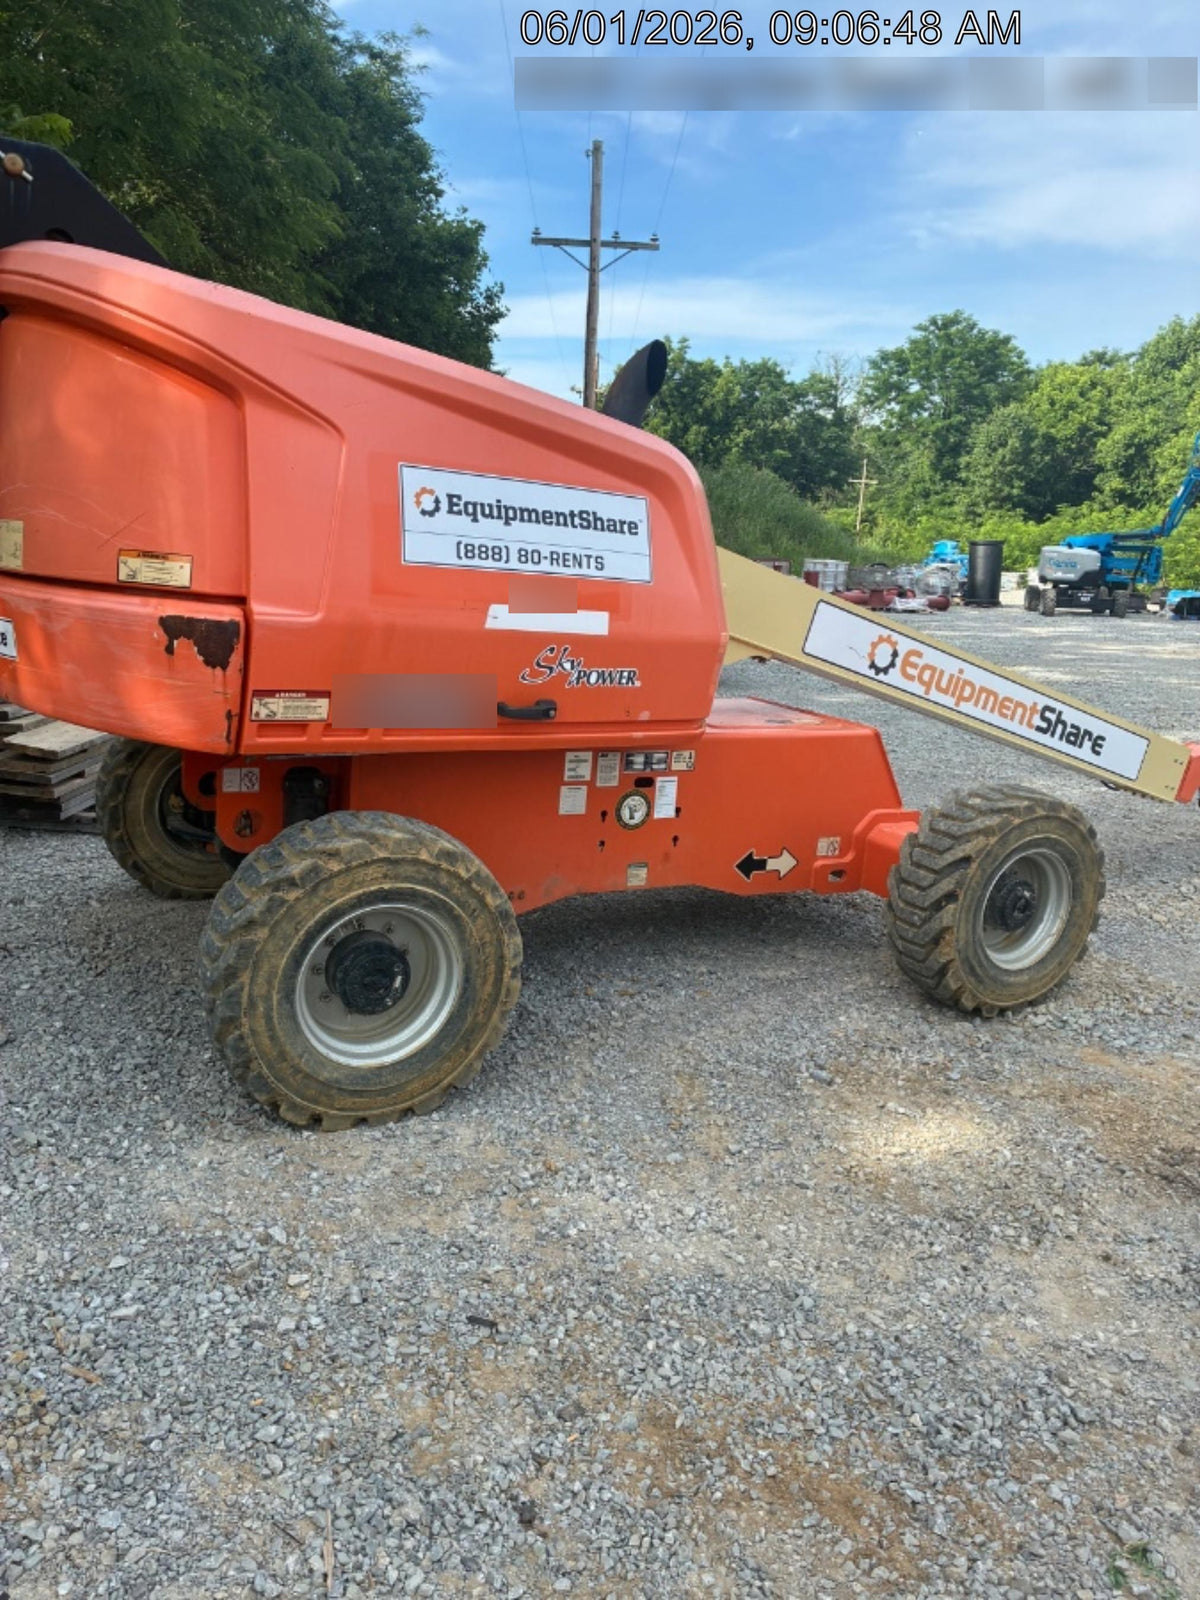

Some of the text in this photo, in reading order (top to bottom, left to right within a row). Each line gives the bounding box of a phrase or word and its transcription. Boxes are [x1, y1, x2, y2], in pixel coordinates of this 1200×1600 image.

[446, 493, 639, 536] EquipmentShare
[456, 541, 605, 571] (888) 80-RENTS
[575, 668, 638, 687] POWER
[899, 649, 1106, 756] EquipmentShare
